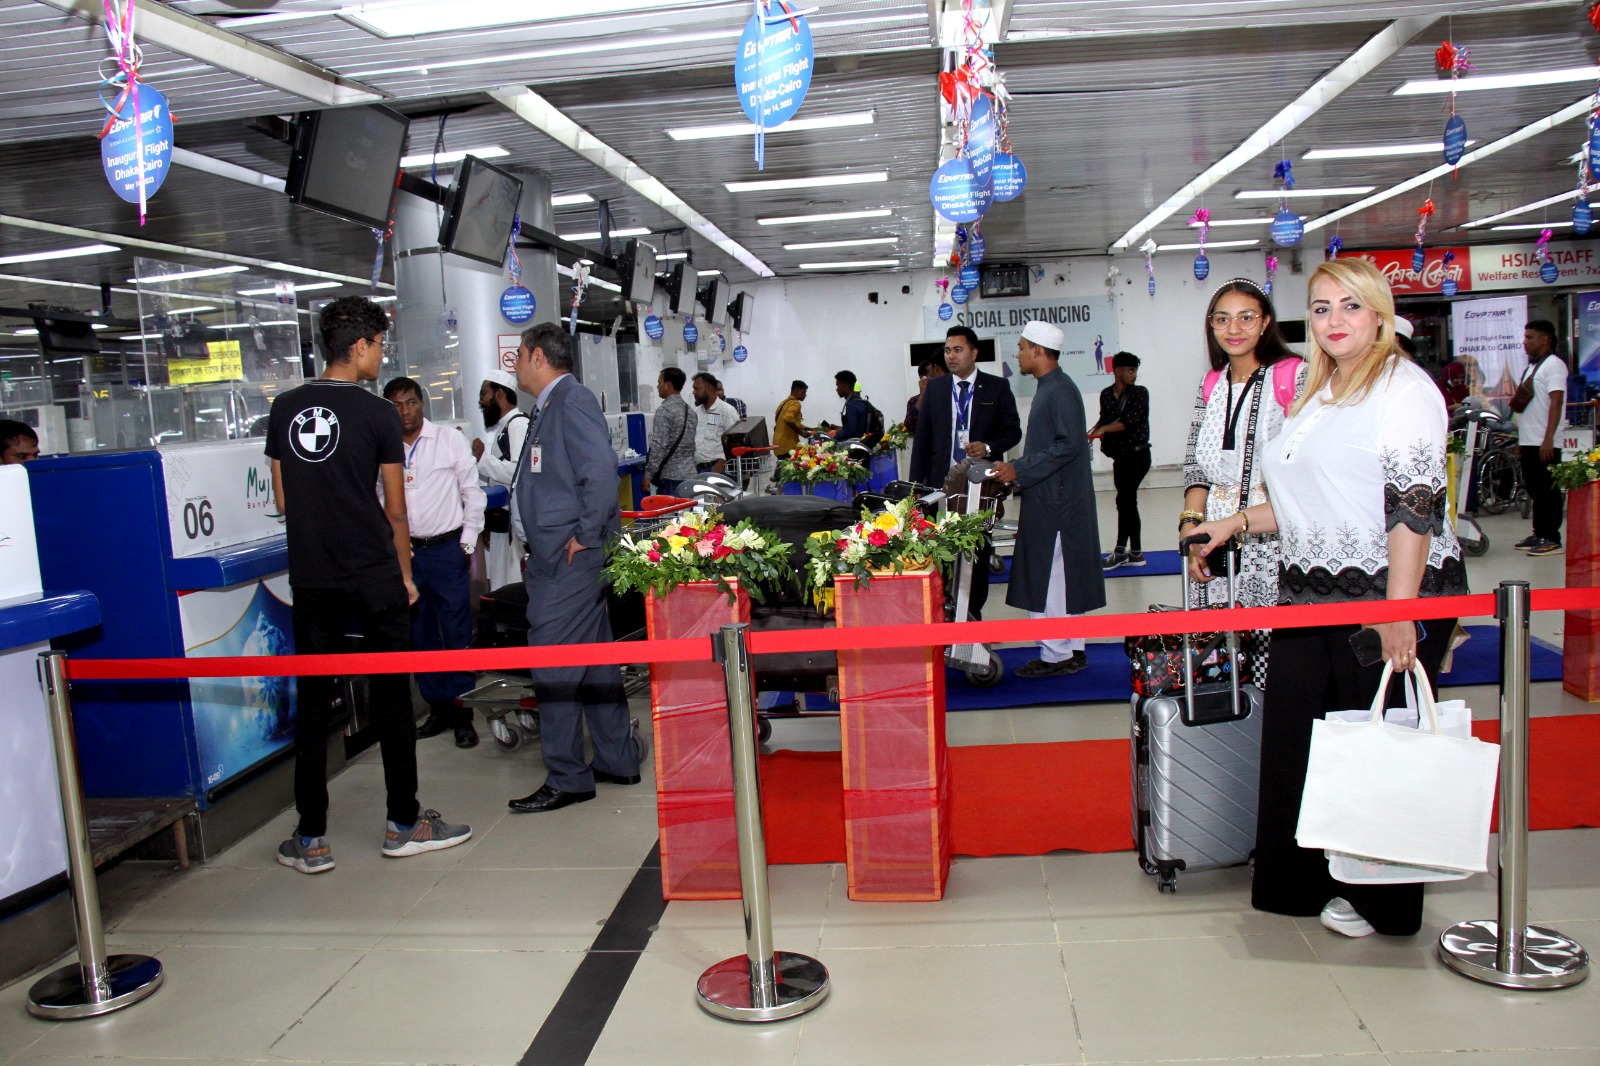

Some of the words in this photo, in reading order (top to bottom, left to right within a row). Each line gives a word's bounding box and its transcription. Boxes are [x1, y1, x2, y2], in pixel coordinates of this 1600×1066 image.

[783, 57, 809, 77] Flight
[107, 151, 140, 168] Inaugur
[145, 140, 169, 156] Flight
[114, 159, 163, 181] DhakaCairo
[937, 174, 974, 183] EGYPTA
[935, 192, 969, 202] Inaugural
[970, 190, 991, 199] Flight
[942, 200, 986, 210] Dhaka-Cairo
[1502, 253, 1540, 267] HSIA
[1548, 249, 1593, 265] STAFF
[1478, 270, 1519, 281] Welfare
[1521, 267, 1579, 279] Resrent
[957, 310, 1006, 328] SOCIAL
[1009, 304, 1091, 327] DISTANCING
[1464, 310, 1507, 320] EGYPTAIR
[1459, 345, 1487, 353] DHAKA
[1497, 343, 1523, 351] CAIRO
[1251, 380, 1262, 410] FOREVER
[295, 408, 337, 425] BMW
[1248, 411, 1259, 435] YOUNG
[533, 456, 539, 466] P
[1243, 440, 1254, 471] FOREVER
[1241, 472, 1250, 496] YOUNG
[183, 500, 215, 540] 06
